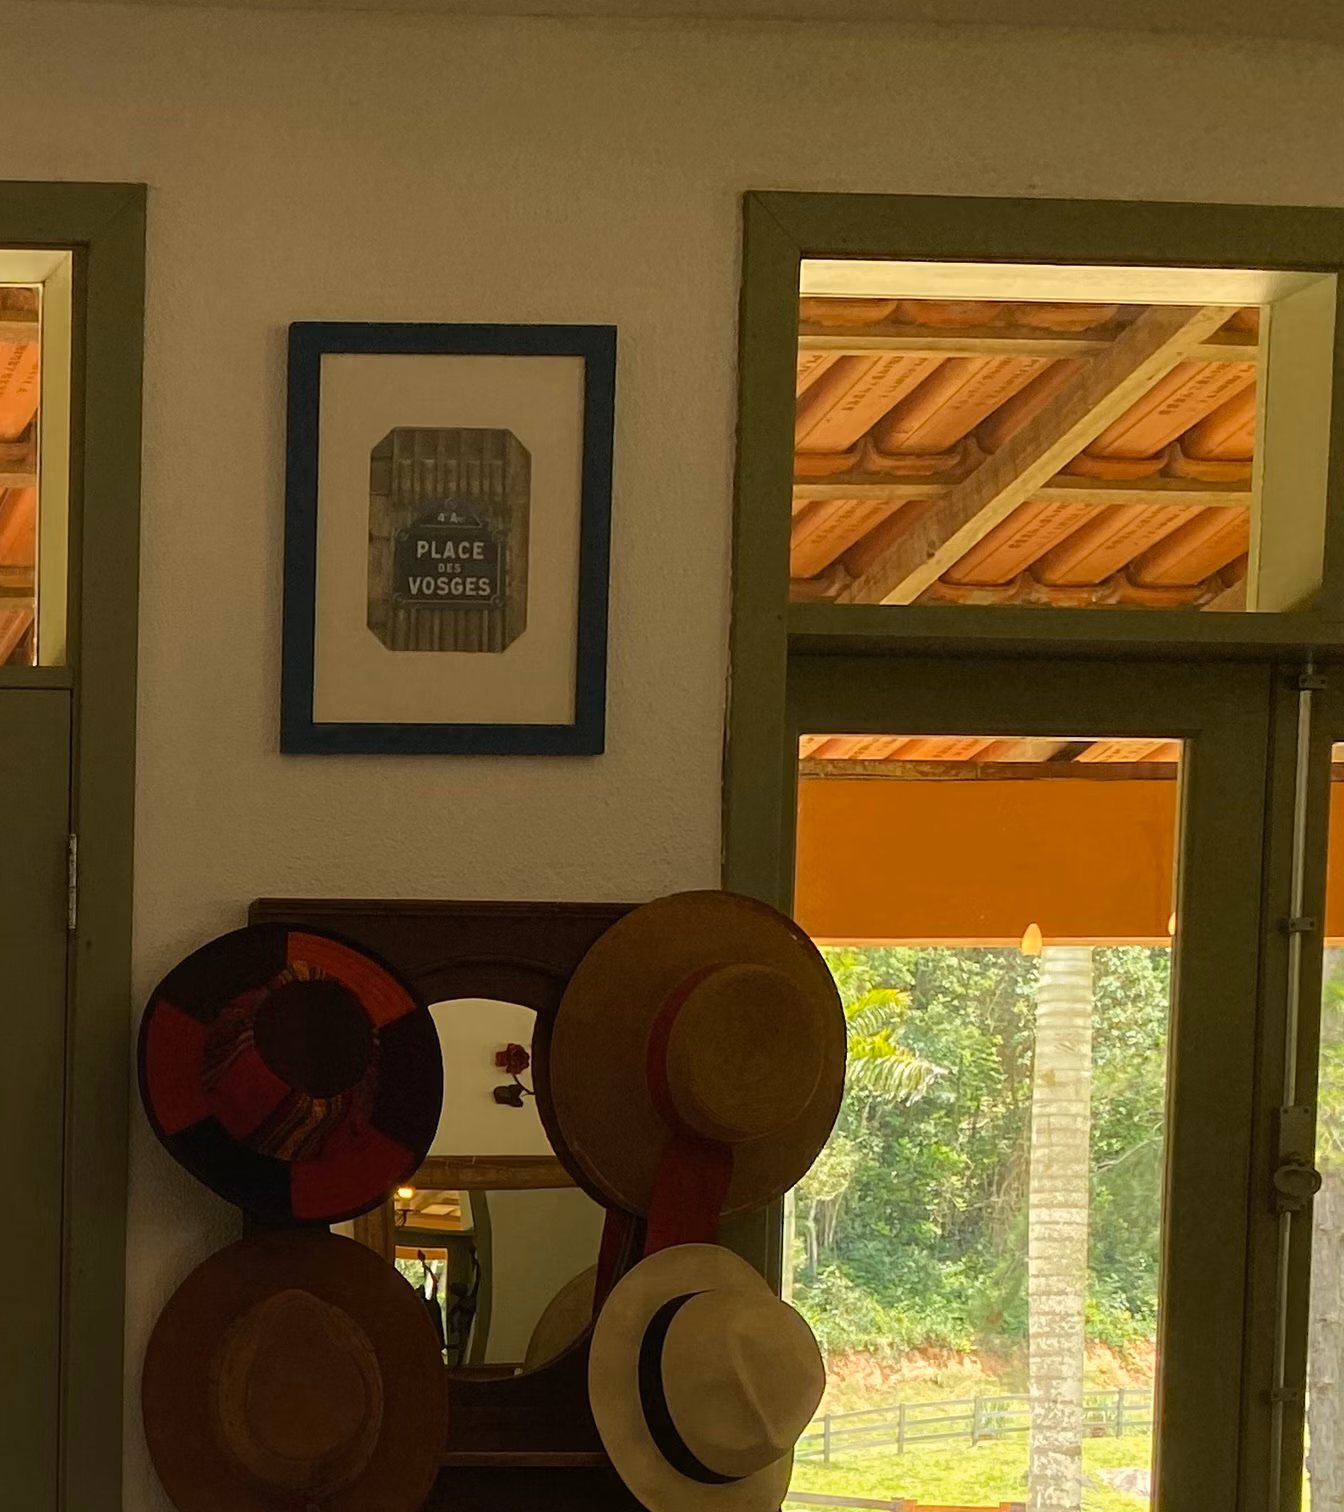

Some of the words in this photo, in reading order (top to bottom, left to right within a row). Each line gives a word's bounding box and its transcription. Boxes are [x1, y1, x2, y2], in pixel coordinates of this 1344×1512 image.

[416, 540, 485, 560] PLACE
[437, 563, 462, 573] DES
[408, 576, 491, 596] VOSGES
